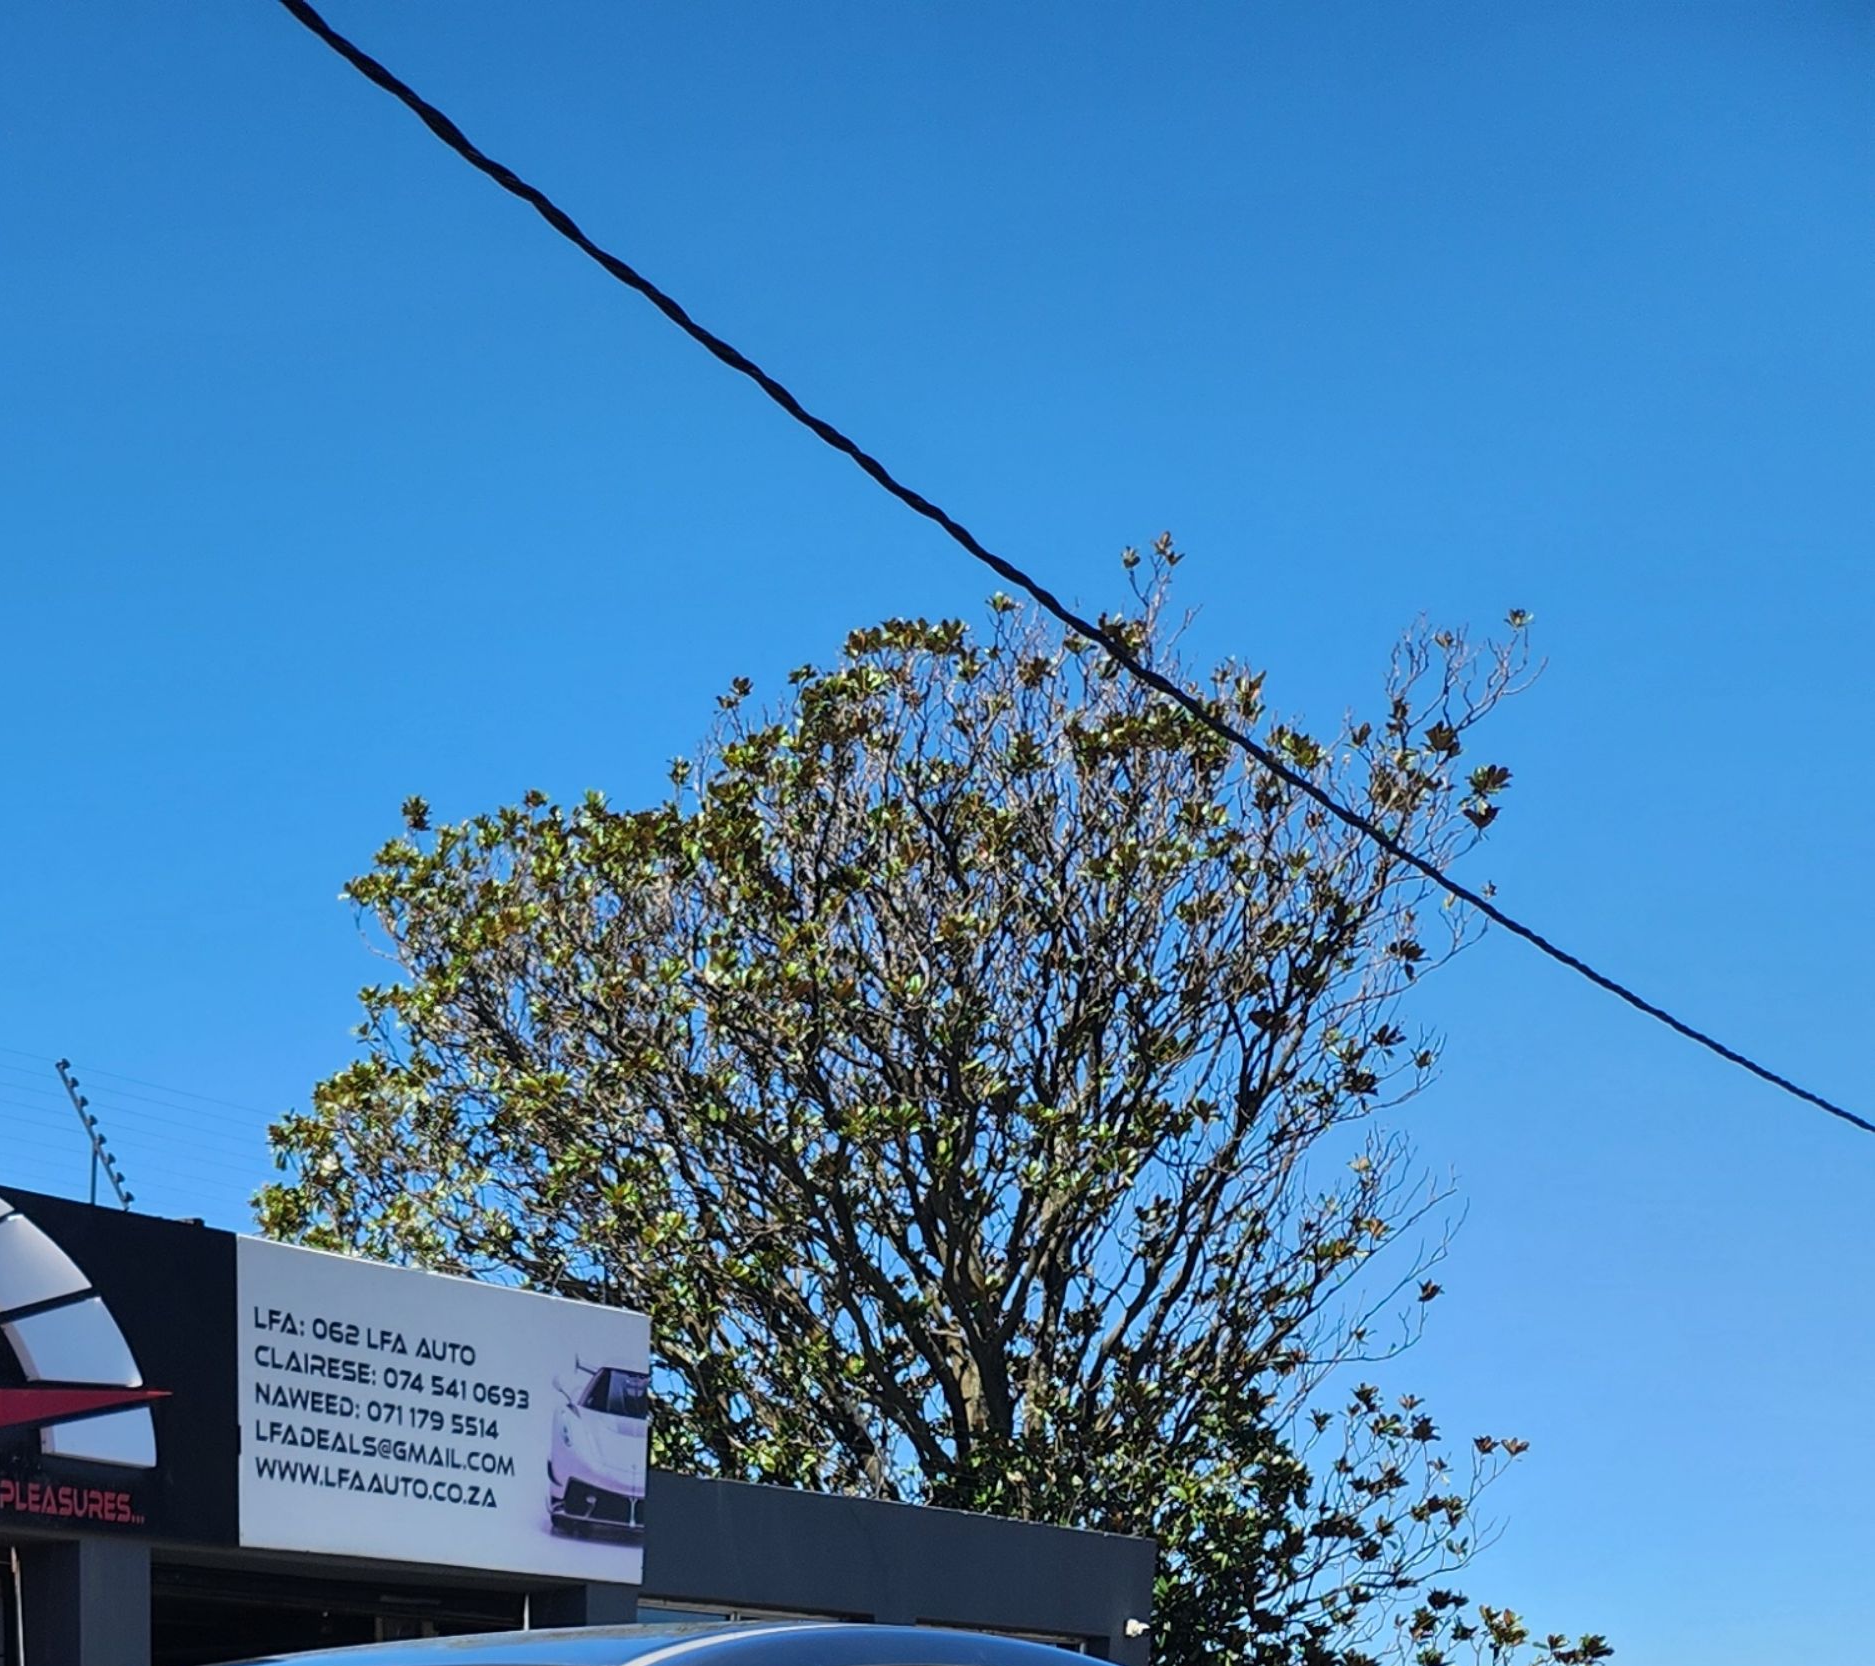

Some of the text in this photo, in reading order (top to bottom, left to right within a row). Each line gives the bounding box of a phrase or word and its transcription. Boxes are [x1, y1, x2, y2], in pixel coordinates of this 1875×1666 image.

[253, 1306, 476, 1367] LFA: 062 LFA AUTO
[254, 1346, 530, 1410] CLAIRESE: 074 541 0693
[255, 1382, 499, 1440] NAWEED: 071 179 5514
[255, 1420, 516, 1477] LFADEALS@GMAIL.COM
[255, 1457, 498, 1509] WWW.LFAAUTO.CO.ZA
